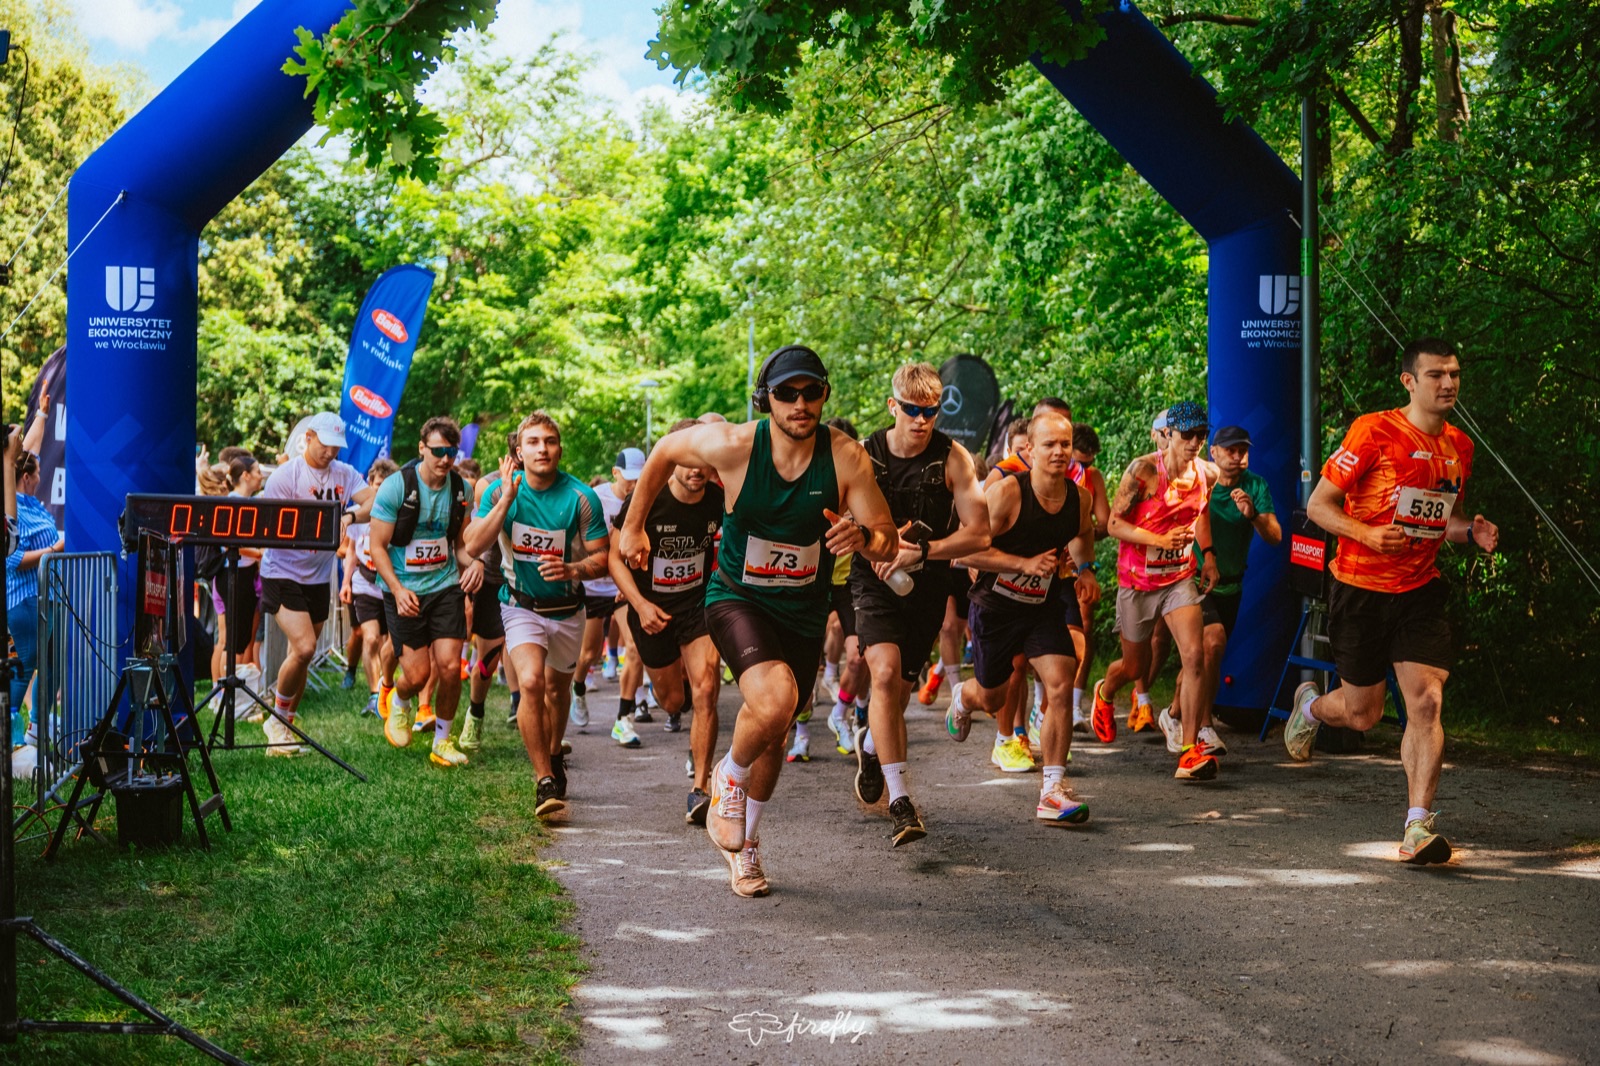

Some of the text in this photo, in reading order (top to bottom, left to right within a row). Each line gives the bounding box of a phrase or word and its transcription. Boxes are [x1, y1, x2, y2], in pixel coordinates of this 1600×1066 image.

[88, 317, 172, 328] UNIWERSYTET
[1241, 320, 1301, 328] UNIWERSYT
[88, 328, 172, 339] EKONOMICZNY
[1240, 330, 1300, 338] EKONOMICZ
[94, 339, 166, 350] we Wrocławiu
[362, 339, 370, 349] w
[376, 337, 391, 353] Jak
[1262, 339, 1301, 348] Wrocław
[355, 414, 371, 429] Jak
[1410, 499, 1444, 519] 538
[522, 533, 554, 550] 327
[415, 545, 441, 558] 572
[1156, 547, 1184, 560] 780
[1292, 541, 1324, 558] DATASPORT
[770, 550, 798, 569] 73
[663, 562, 696, 579] 635
[1011, 573, 1041, 588] 778
